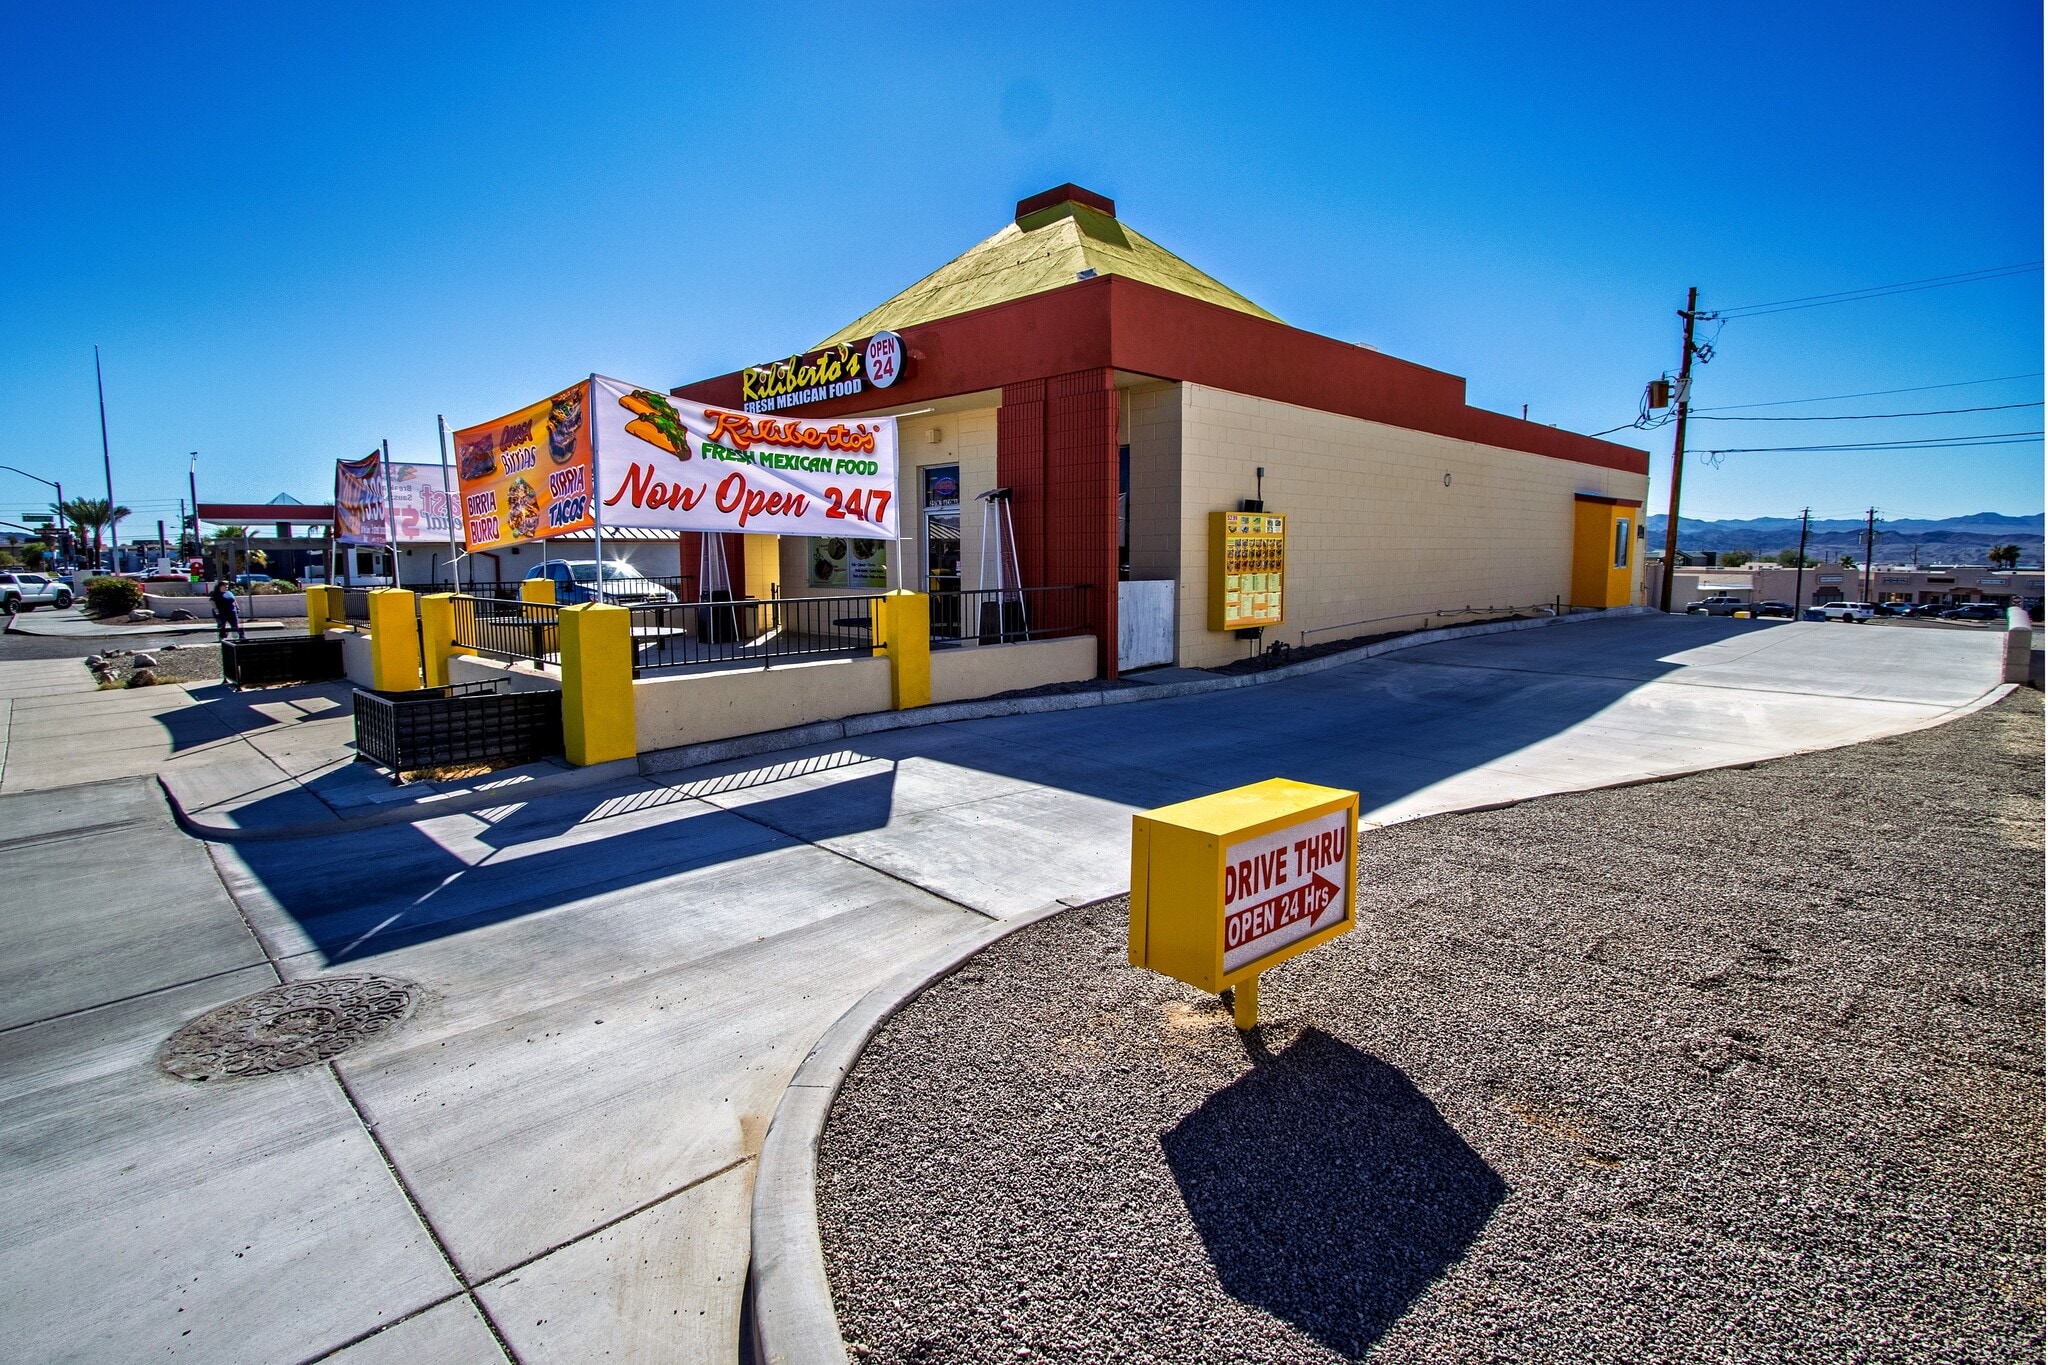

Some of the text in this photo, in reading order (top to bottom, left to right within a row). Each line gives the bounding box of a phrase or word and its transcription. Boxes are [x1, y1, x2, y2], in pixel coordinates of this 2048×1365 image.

[870, 337, 895, 358] OPEN
[743, 342, 861, 401] Riliberto's
[873, 356, 894, 380] 24
[743, 379, 862, 414] FRESH MEXICAN FOOD
[704, 409, 875, 453] Riliberto's
[702, 443, 879, 475] FRESH MEXICAN FOOD
[549, 465, 585, 498] BIRRIA
[603, 462, 892, 527] Now Open 24/7
[467, 492, 498, 517] BIRRIA
[549, 496, 587, 528] TACOS
[470, 515, 499, 544] BURRO
[1225, 826, 1345, 906] DRIVE THRU
[1228, 883, 1330, 947] OPEN 24 Hrs
